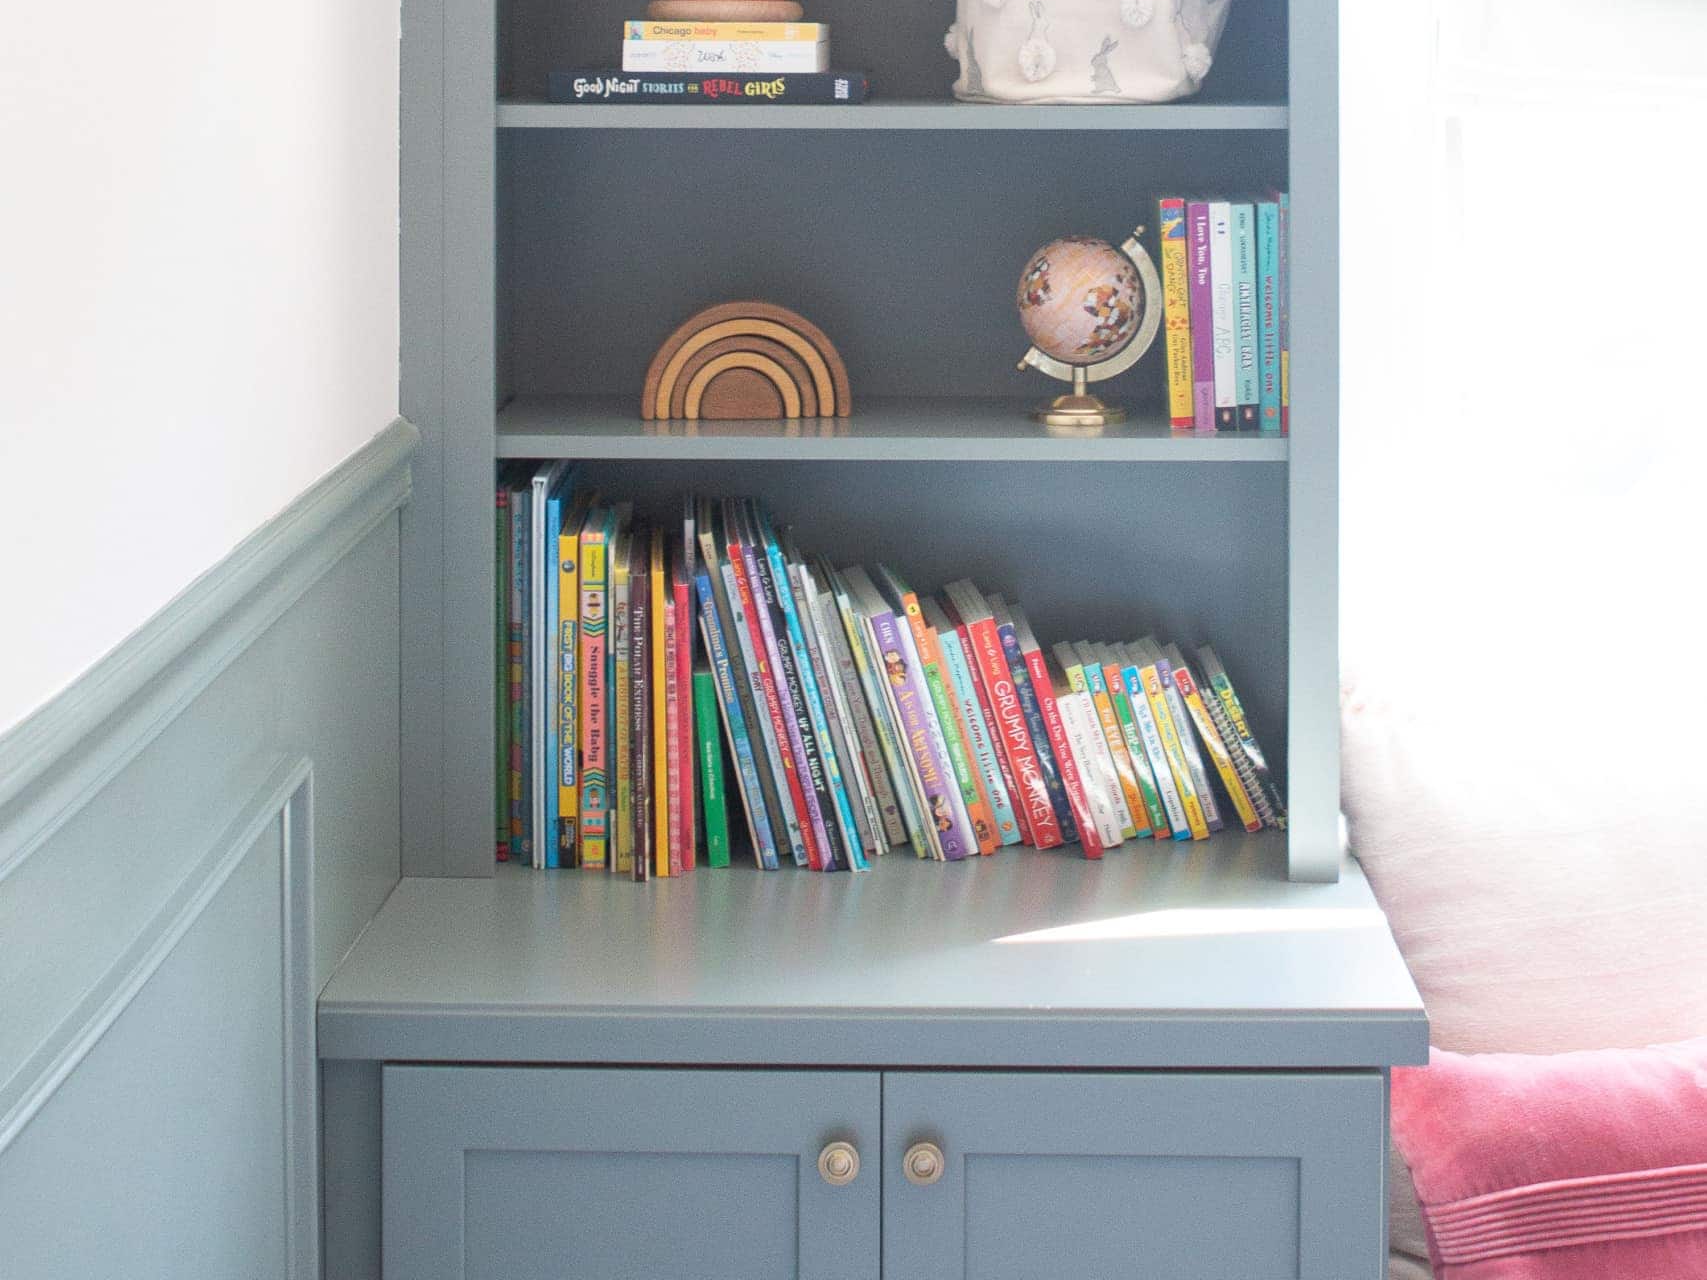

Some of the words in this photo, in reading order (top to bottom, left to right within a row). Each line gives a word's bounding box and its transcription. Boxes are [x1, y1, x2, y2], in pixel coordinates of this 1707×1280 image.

[652, 25, 692, 38] Chicago
[642, 81, 684, 94] STORIES
[702, 78, 742, 98] REBEL
[744, 77, 786, 99] GIRLS
[1197, 268, 1207, 285] Too
[1264, 275, 1273, 328] welcome
[1264, 333, 1273, 366] little
[1264, 373, 1273, 393] one
[562, 621, 573, 650] FIRST
[879, 621, 894, 643] CHEN
[562, 652, 573, 672] BIG
[633, 636, 644, 674] POLAR
[777, 639, 792, 674] GRUMPY
[588, 646, 600, 698] Snuggle
[562, 672, 573, 704] BOOK
[787, 677, 802, 712] MONKEY
[898, 689, 914, 701] A
[562, 706, 573, 720] OF
[590, 703, 599, 724] the
[633, 678, 644, 730] EXPRESS
[1044, 696, 1054, 710] On
[763, 678, 778, 713] GRUMPY
[773, 716, 788, 752] MONKEY
[798, 717, 808, 731] UP
[1048, 711, 1058, 723] the
[562, 724, 573, 744] THE
[1051, 725, 1063, 741] Day
[588, 729, 599, 762] Baby
[802, 734, 814, 755] ALL
[963, 698, 985, 748] welcome
[992, 789, 1003, 808] one
[994, 680, 1028, 751] GRUMPY
[1017, 756, 1052, 828] MONKEY
[1058, 742, 1068, 758] You
[562, 745, 573, 786] WORLD
[808, 758, 823, 791] NIGHT
